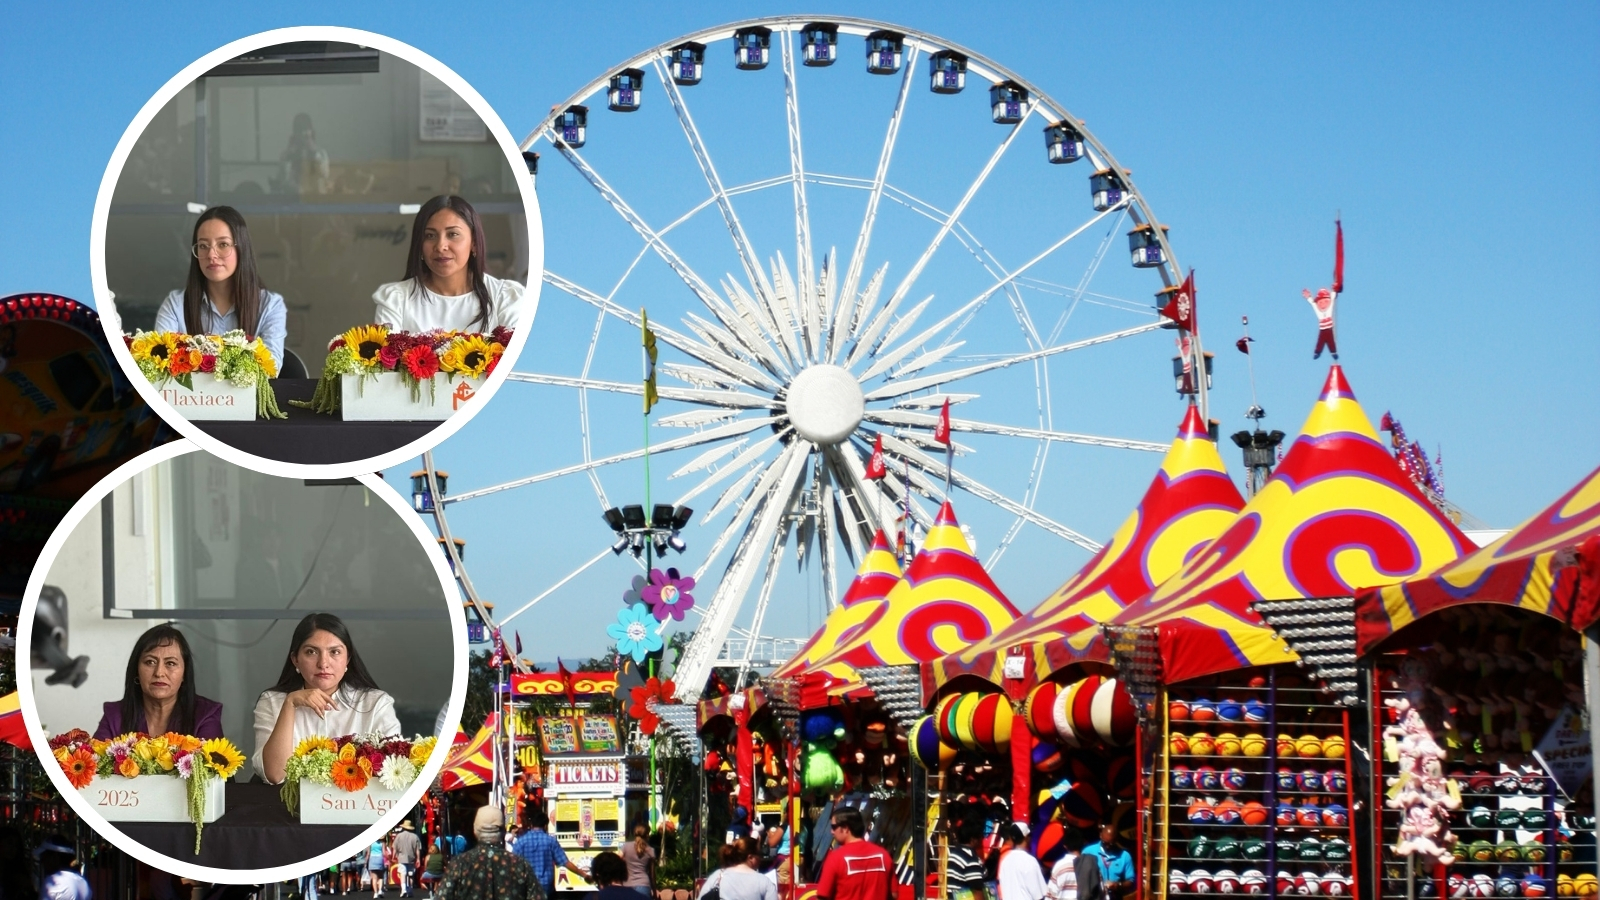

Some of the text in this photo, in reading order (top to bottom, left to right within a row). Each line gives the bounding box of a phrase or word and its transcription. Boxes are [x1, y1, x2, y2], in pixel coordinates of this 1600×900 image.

[158, 389, 235, 407] Tlaxiaca
[1544, 746, 1592, 762] SPECIA
[559, 766, 616, 783] TICKETS
[97, 789, 140, 808] 2025
[321, 792, 356, 811] San
